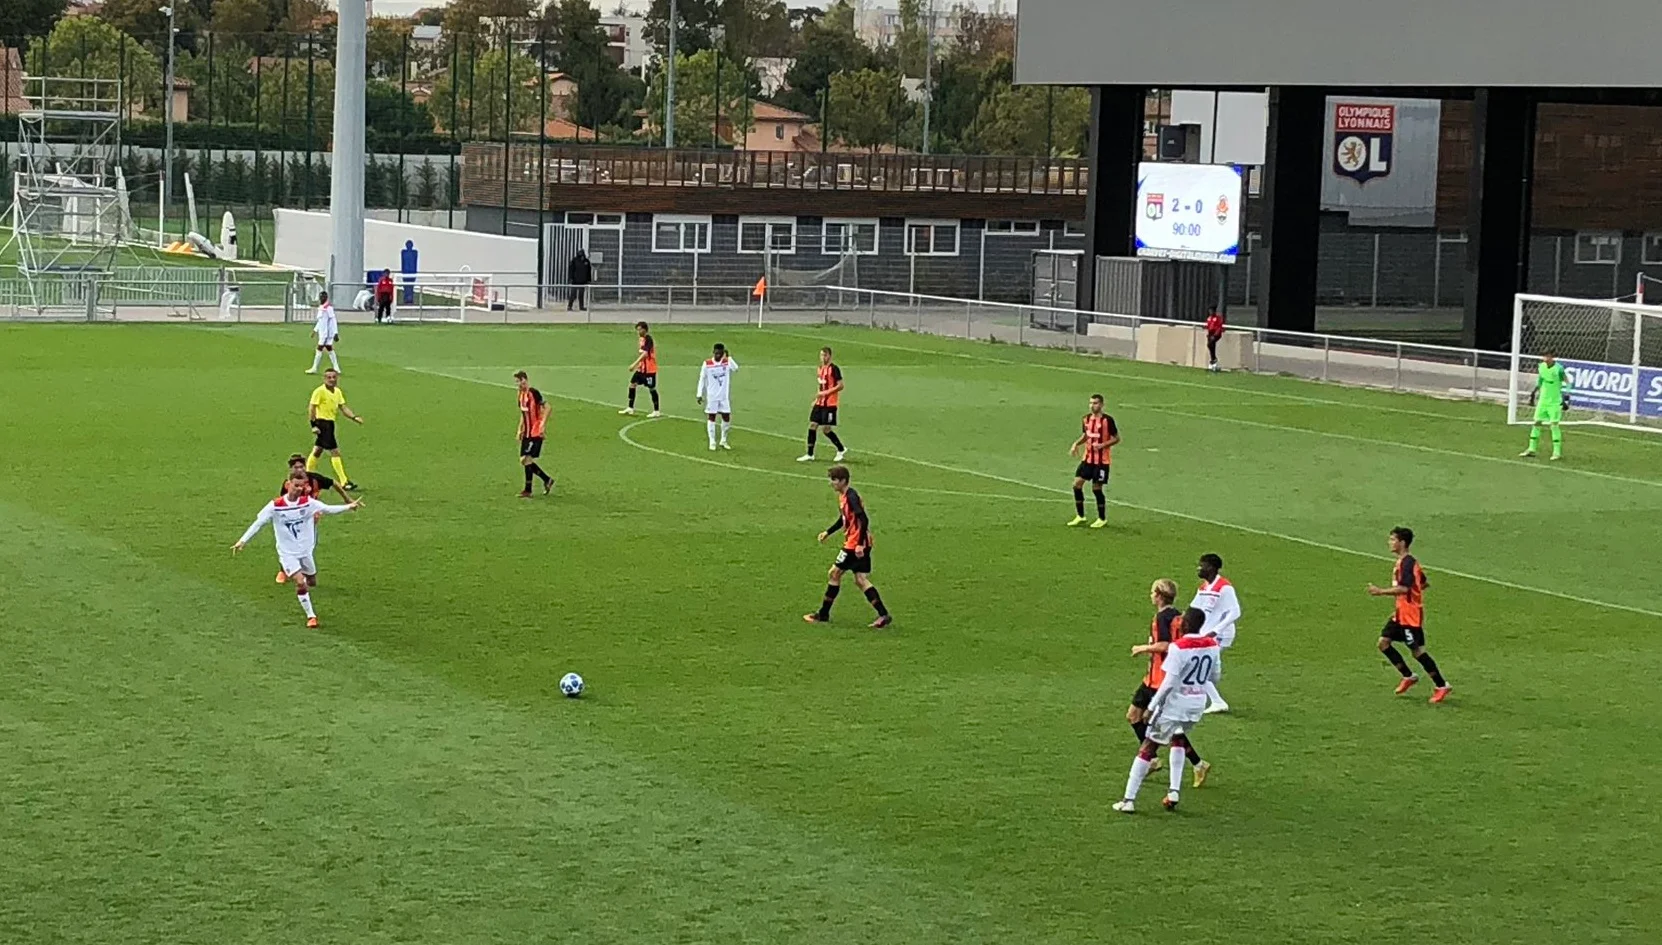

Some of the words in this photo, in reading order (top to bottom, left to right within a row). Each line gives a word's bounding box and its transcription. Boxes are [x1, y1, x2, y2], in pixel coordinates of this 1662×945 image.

[1338, 106, 1391, 118] OLYMPIQUE
[1338, 117, 1391, 129] LYONNAIS
[1172, 198, 1180, 212] 2
[1195, 199, 1203, 214] 0
[1172, 222, 1201, 237] 90:00
[1562, 366, 1632, 393] SWORD
[1183, 655, 1212, 685] 20
